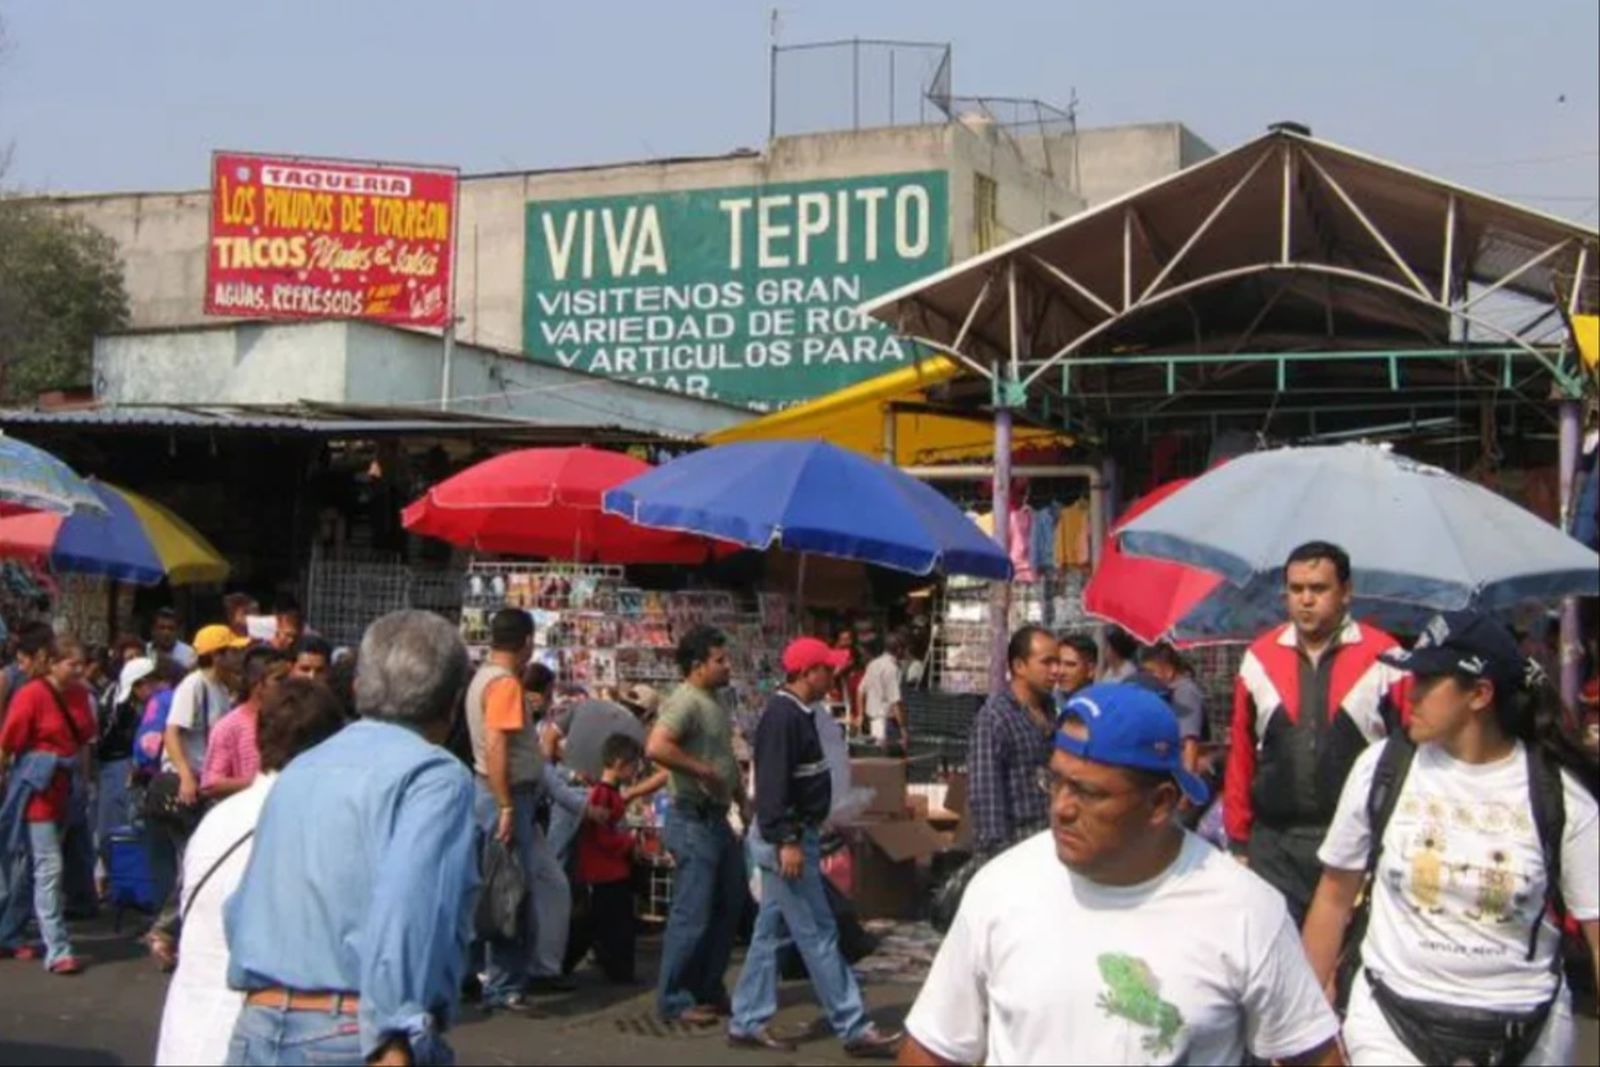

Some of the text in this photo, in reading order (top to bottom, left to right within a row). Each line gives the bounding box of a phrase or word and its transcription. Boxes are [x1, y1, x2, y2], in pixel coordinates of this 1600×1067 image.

[267, 170, 406, 193] TAQUERIA
[341, 196, 364, 233] DE
[372, 198, 449, 240] TORREON
[542, 184, 930, 281] VIVA TEPITO
[213, 236, 307, 268] TACOS
[272, 284, 363, 315] REFRESCOS
[537, 275, 860, 316] VISITENOS GRAN
[540, 306, 887, 345] VARIEDAD DE RO
[588, 340, 791, 373] ARTICULOS
[803, 335, 904, 365] PARA
